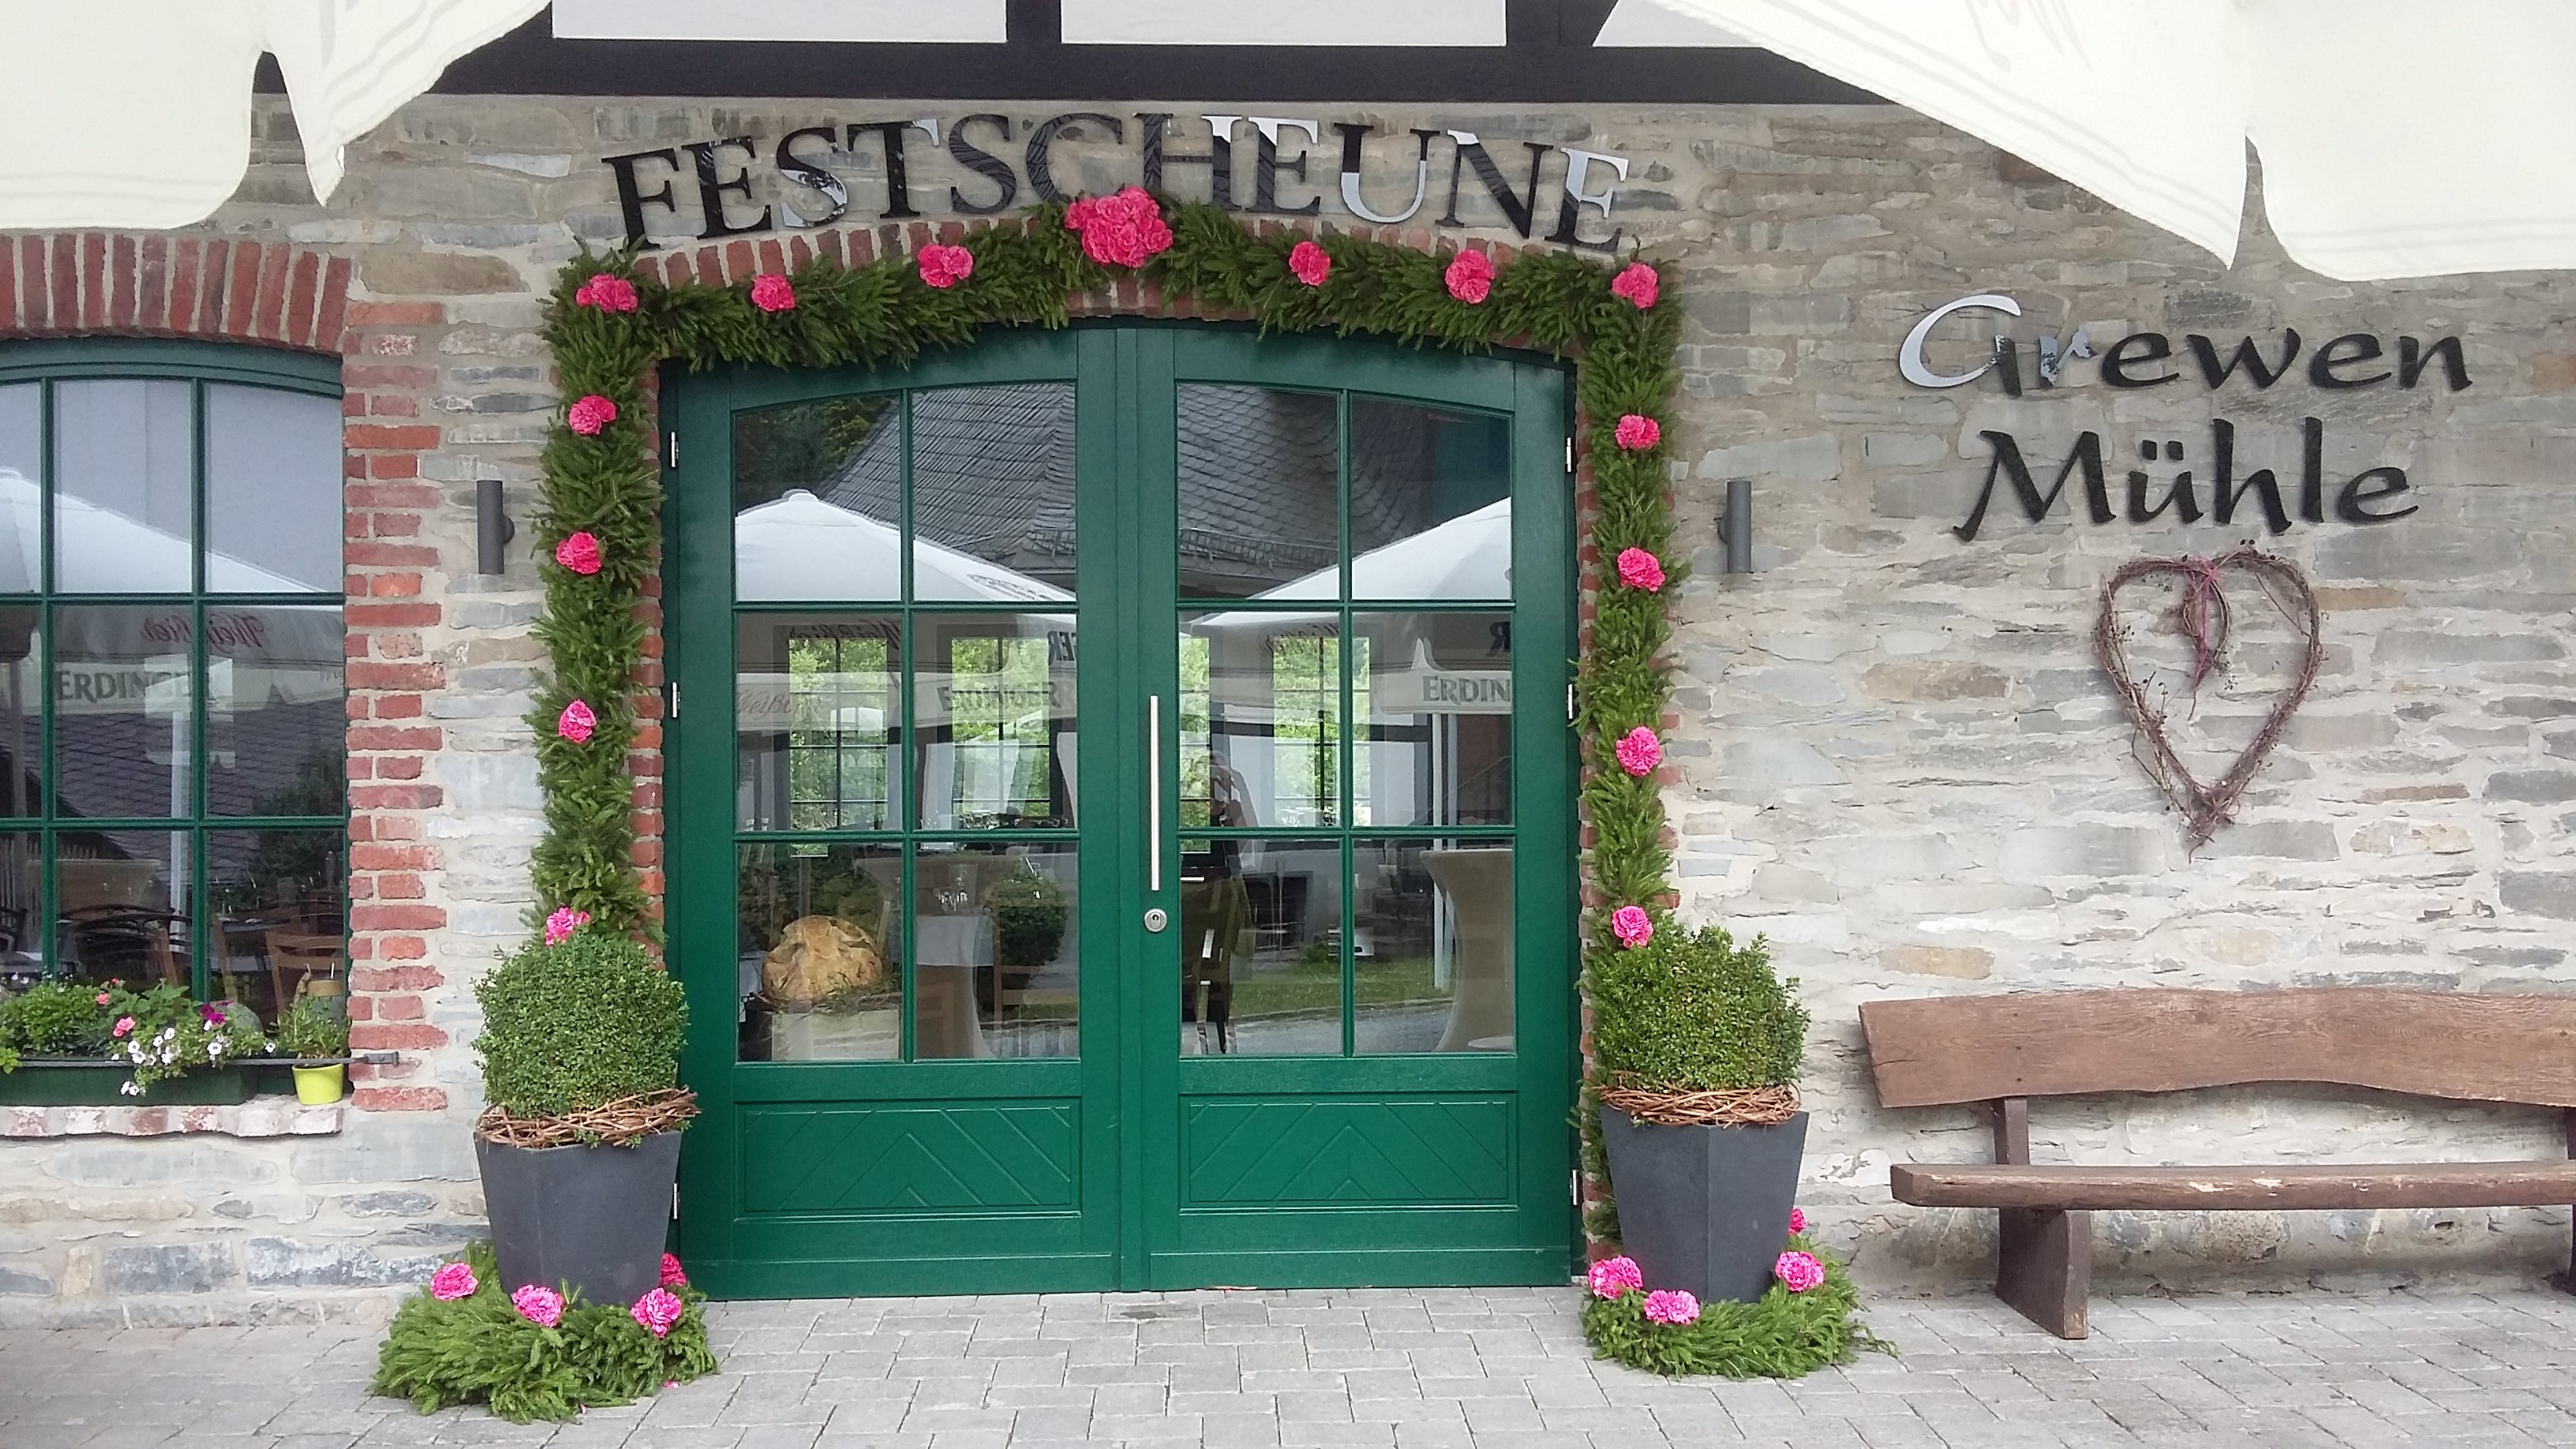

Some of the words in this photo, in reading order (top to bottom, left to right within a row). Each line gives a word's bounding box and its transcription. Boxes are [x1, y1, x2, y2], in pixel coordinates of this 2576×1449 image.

[601, 113, 1629, 253] FESTSCHEUNE
[1898, 294, 2475, 397] Grewen
[1953, 417, 2420, 542] Mühle
